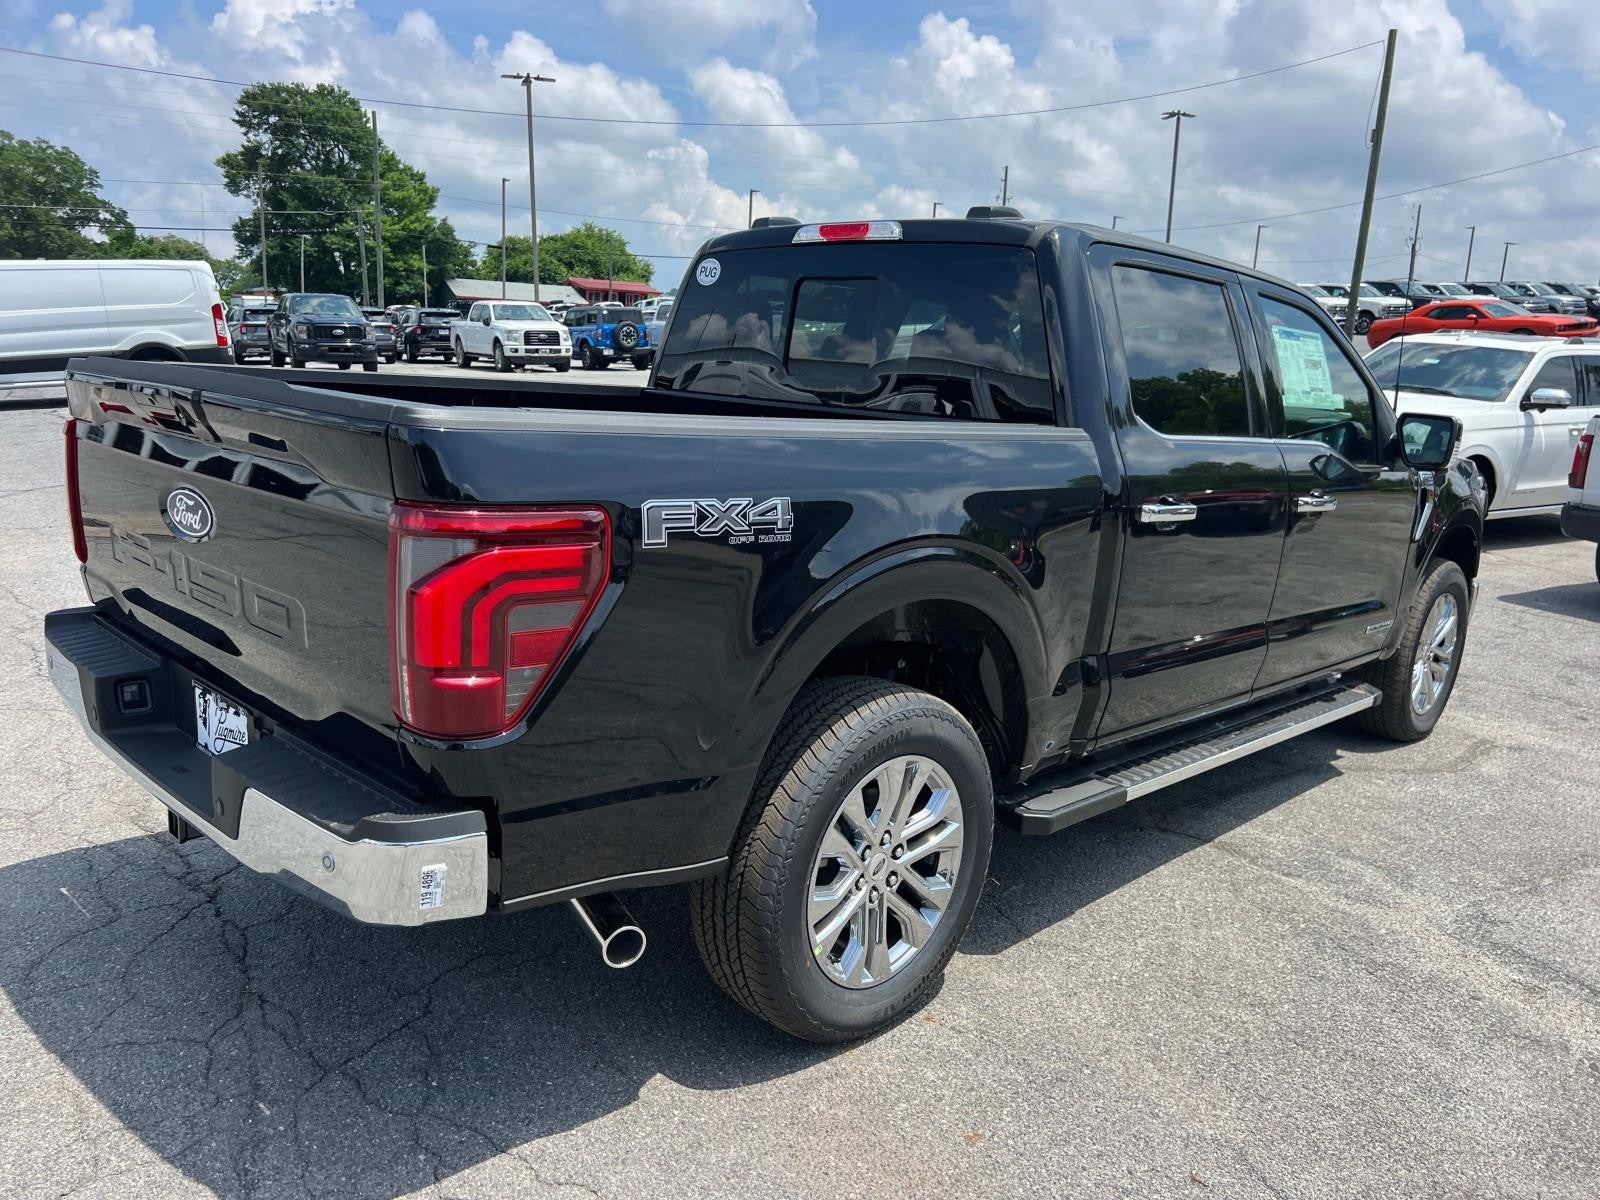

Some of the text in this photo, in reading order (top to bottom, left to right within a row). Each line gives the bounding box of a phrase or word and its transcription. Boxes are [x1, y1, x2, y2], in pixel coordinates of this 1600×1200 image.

[700, 266, 717, 278] PUG
[174, 495, 202, 531] Ford
[640, 497, 793, 549] FX4
[729, 534, 792, 545] OFF ROAD
[213, 708, 247, 754] Pugmire
[420, 892, 432, 907] 119
